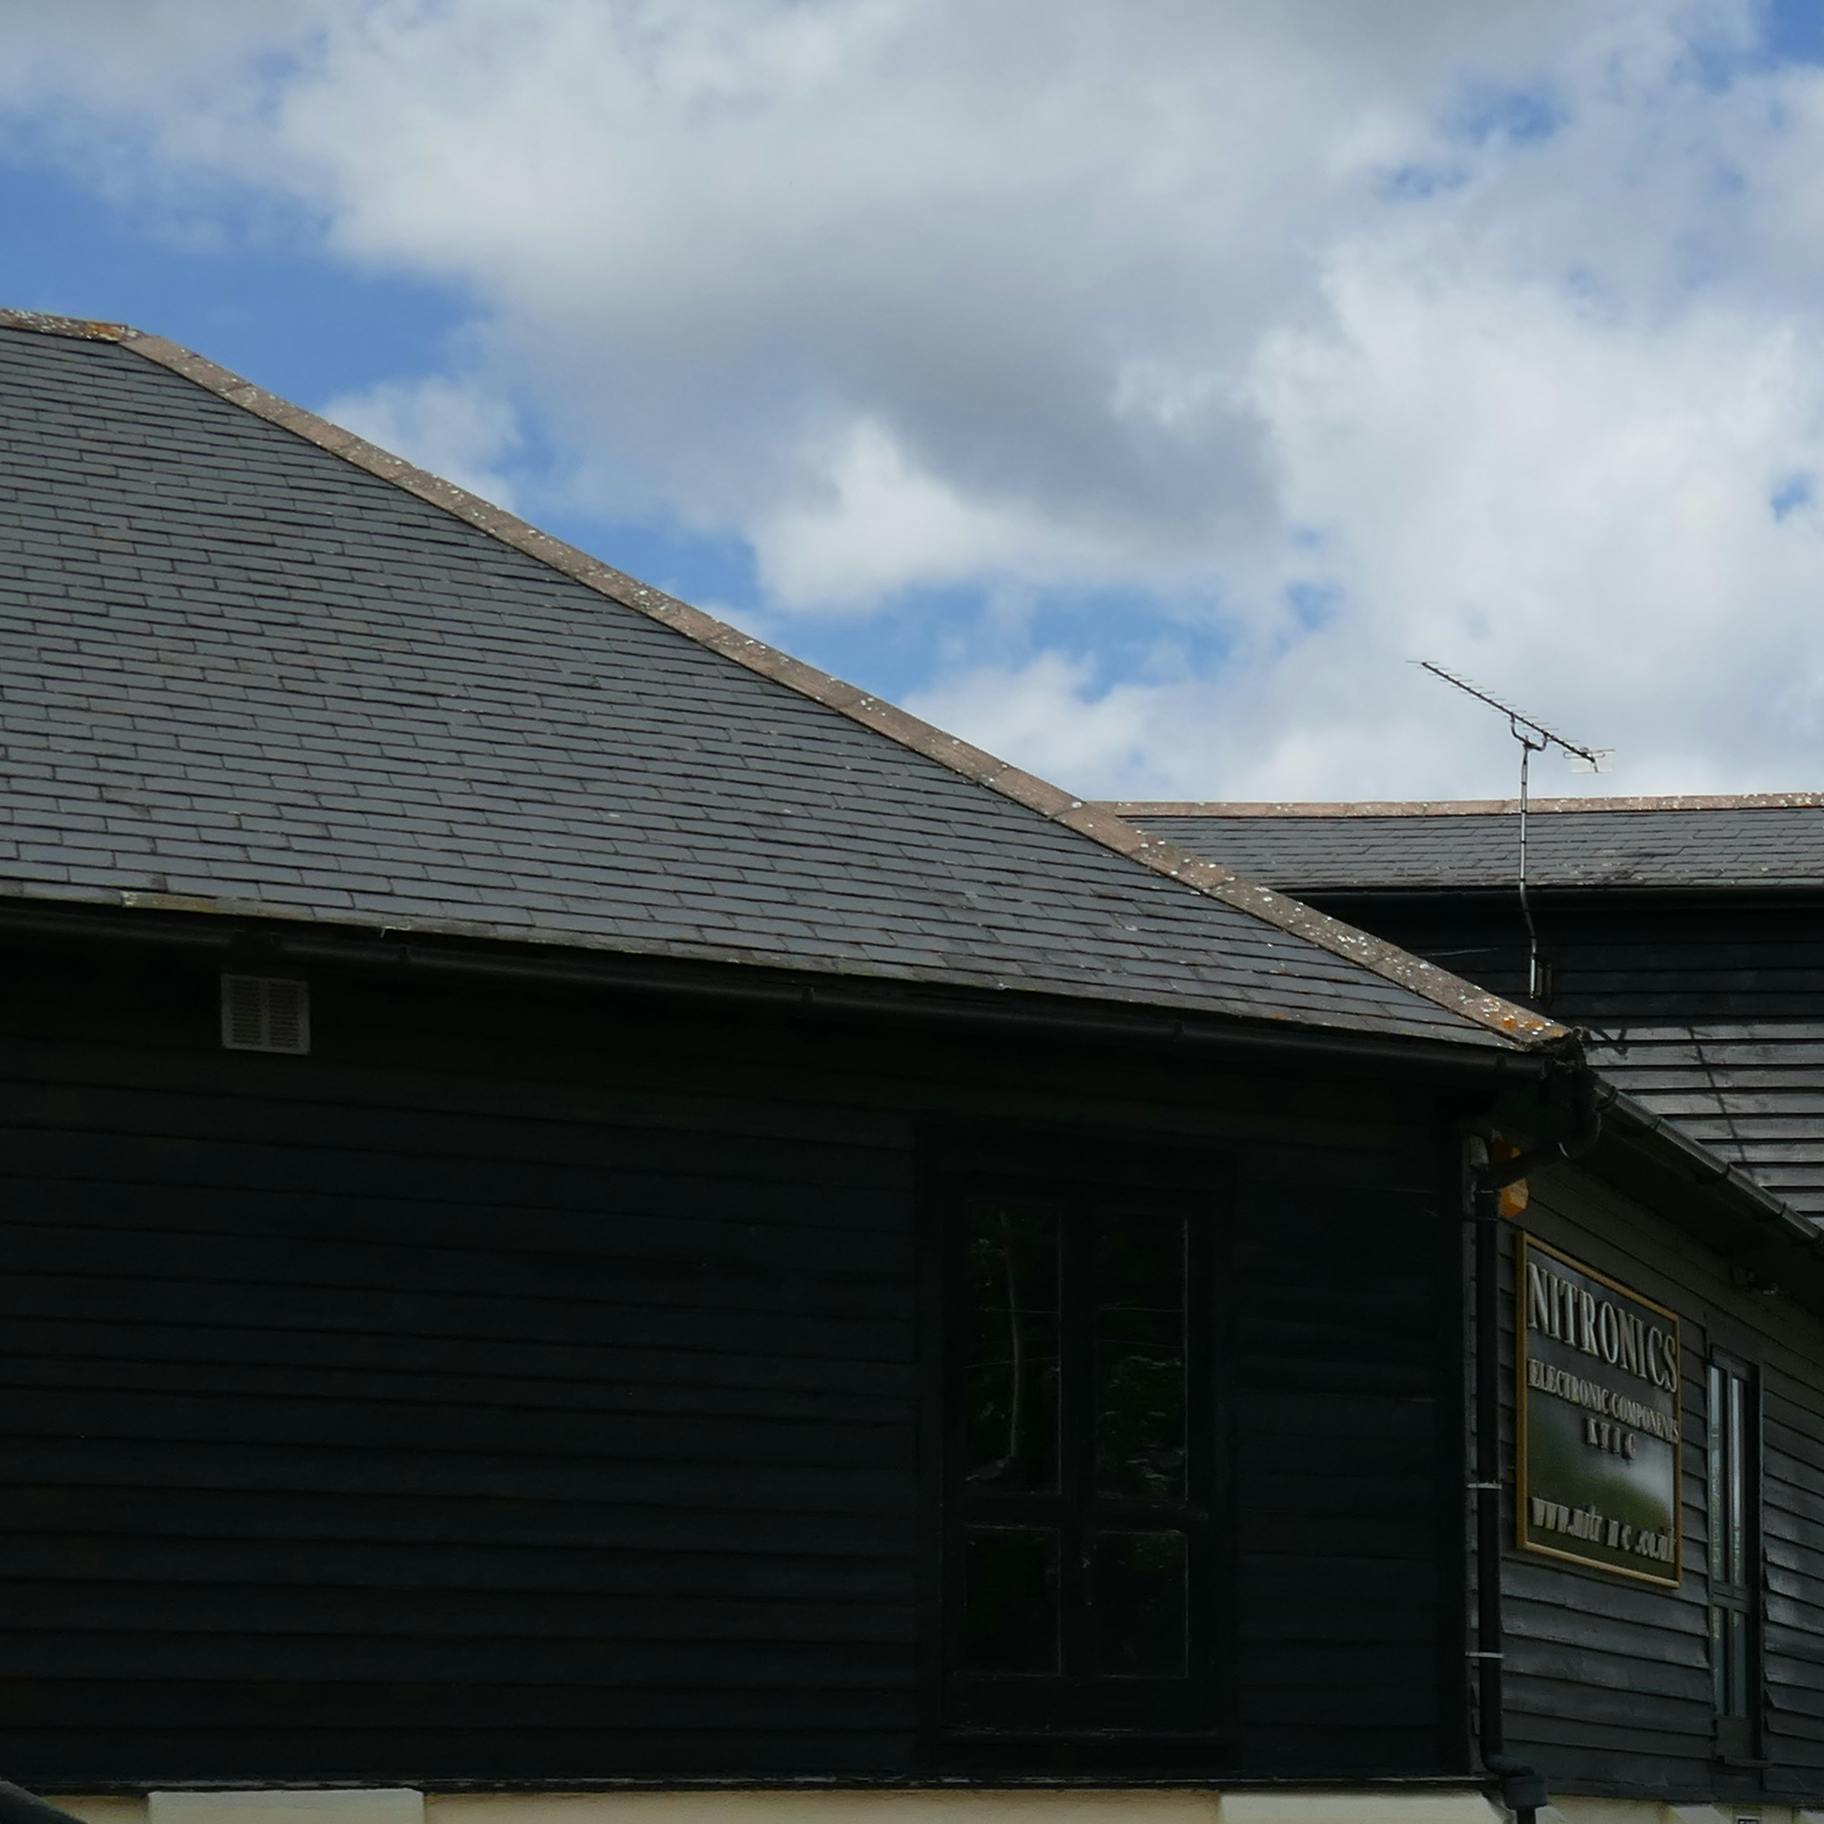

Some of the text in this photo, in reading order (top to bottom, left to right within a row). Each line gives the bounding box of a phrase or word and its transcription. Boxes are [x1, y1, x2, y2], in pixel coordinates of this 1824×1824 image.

[1527, 1262, 1678, 1393] NITRONICS
[1527, 1358, 1611, 1412] ELECTRONIC
[1611, 1391, 1680, 1444] COMPONENTS
